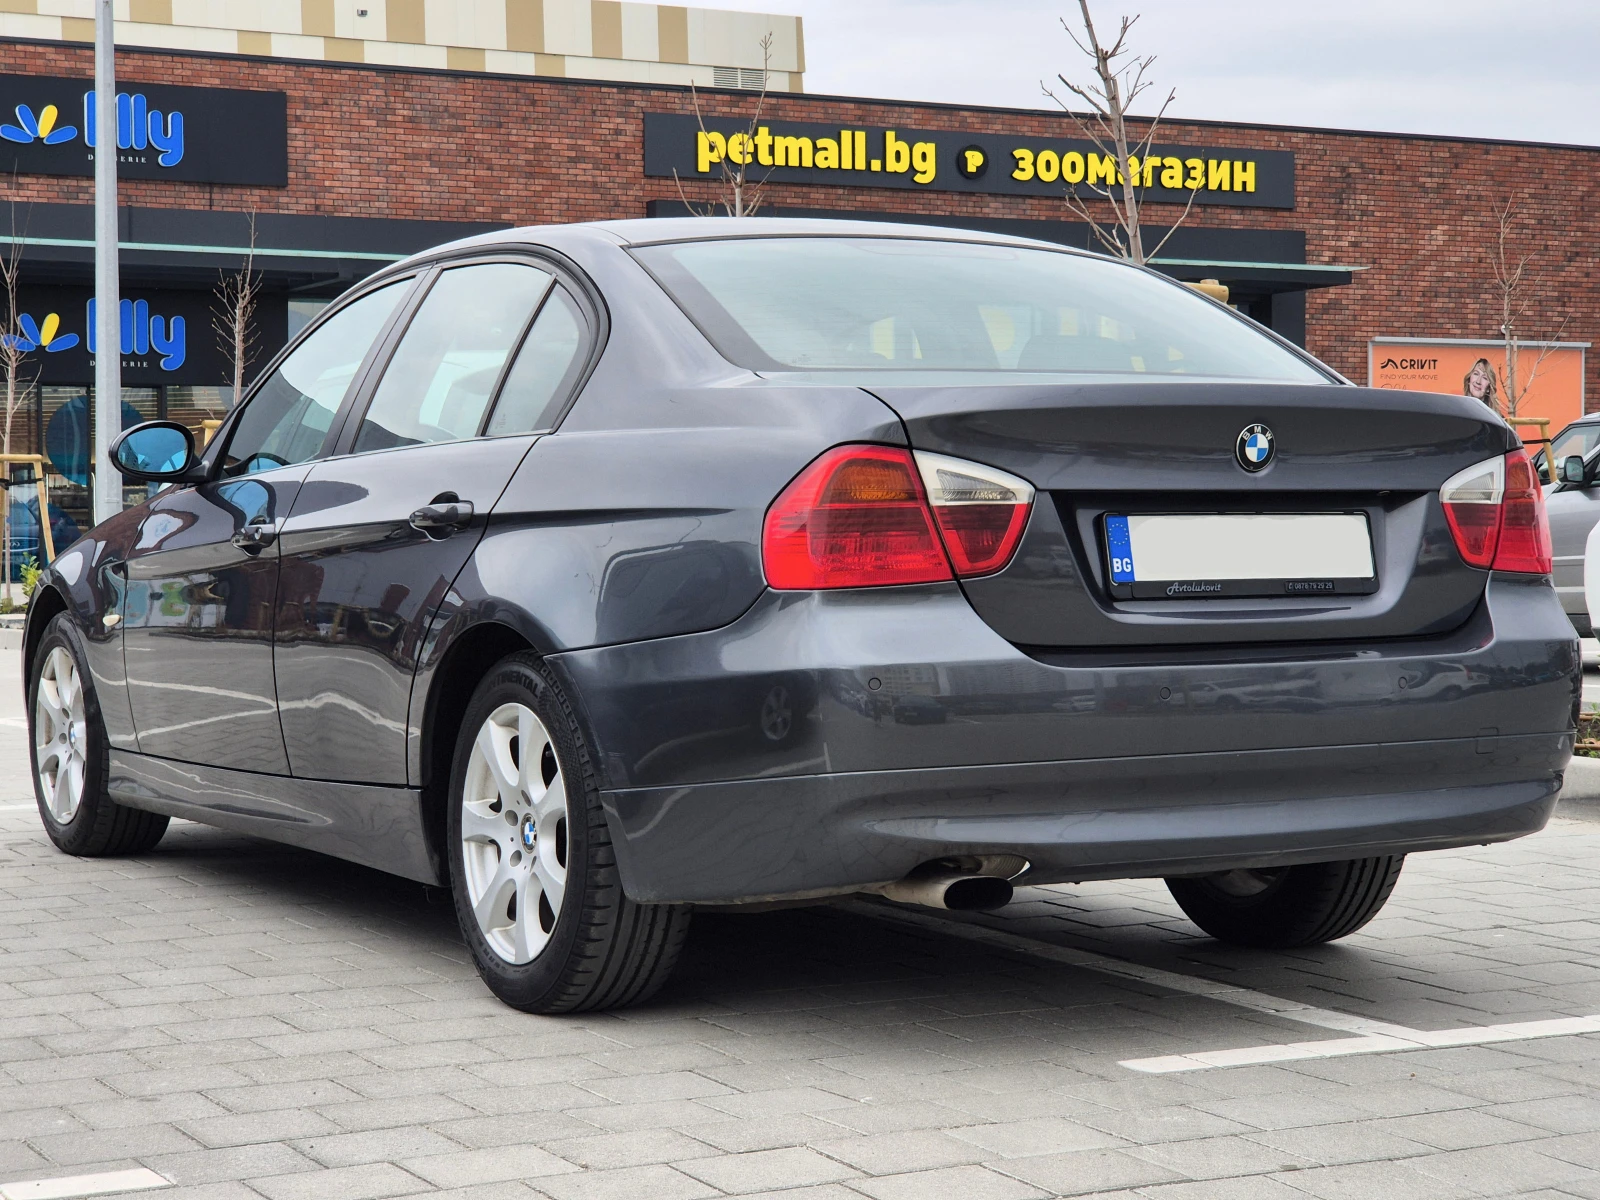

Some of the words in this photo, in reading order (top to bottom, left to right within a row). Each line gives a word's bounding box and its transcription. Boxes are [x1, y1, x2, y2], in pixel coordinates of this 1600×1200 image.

[84, 90, 184, 167] llly
[88, 154, 146, 163] DERIE
[697, 126, 936, 184] petmall.bg
[87, 297, 186, 371] llly
[90, 360, 148, 368] DERIE
[1400, 358, 1438, 370] CRIVIT
[1242, 425, 1273, 441] BMW
[1112, 557, 1132, 573] BG
